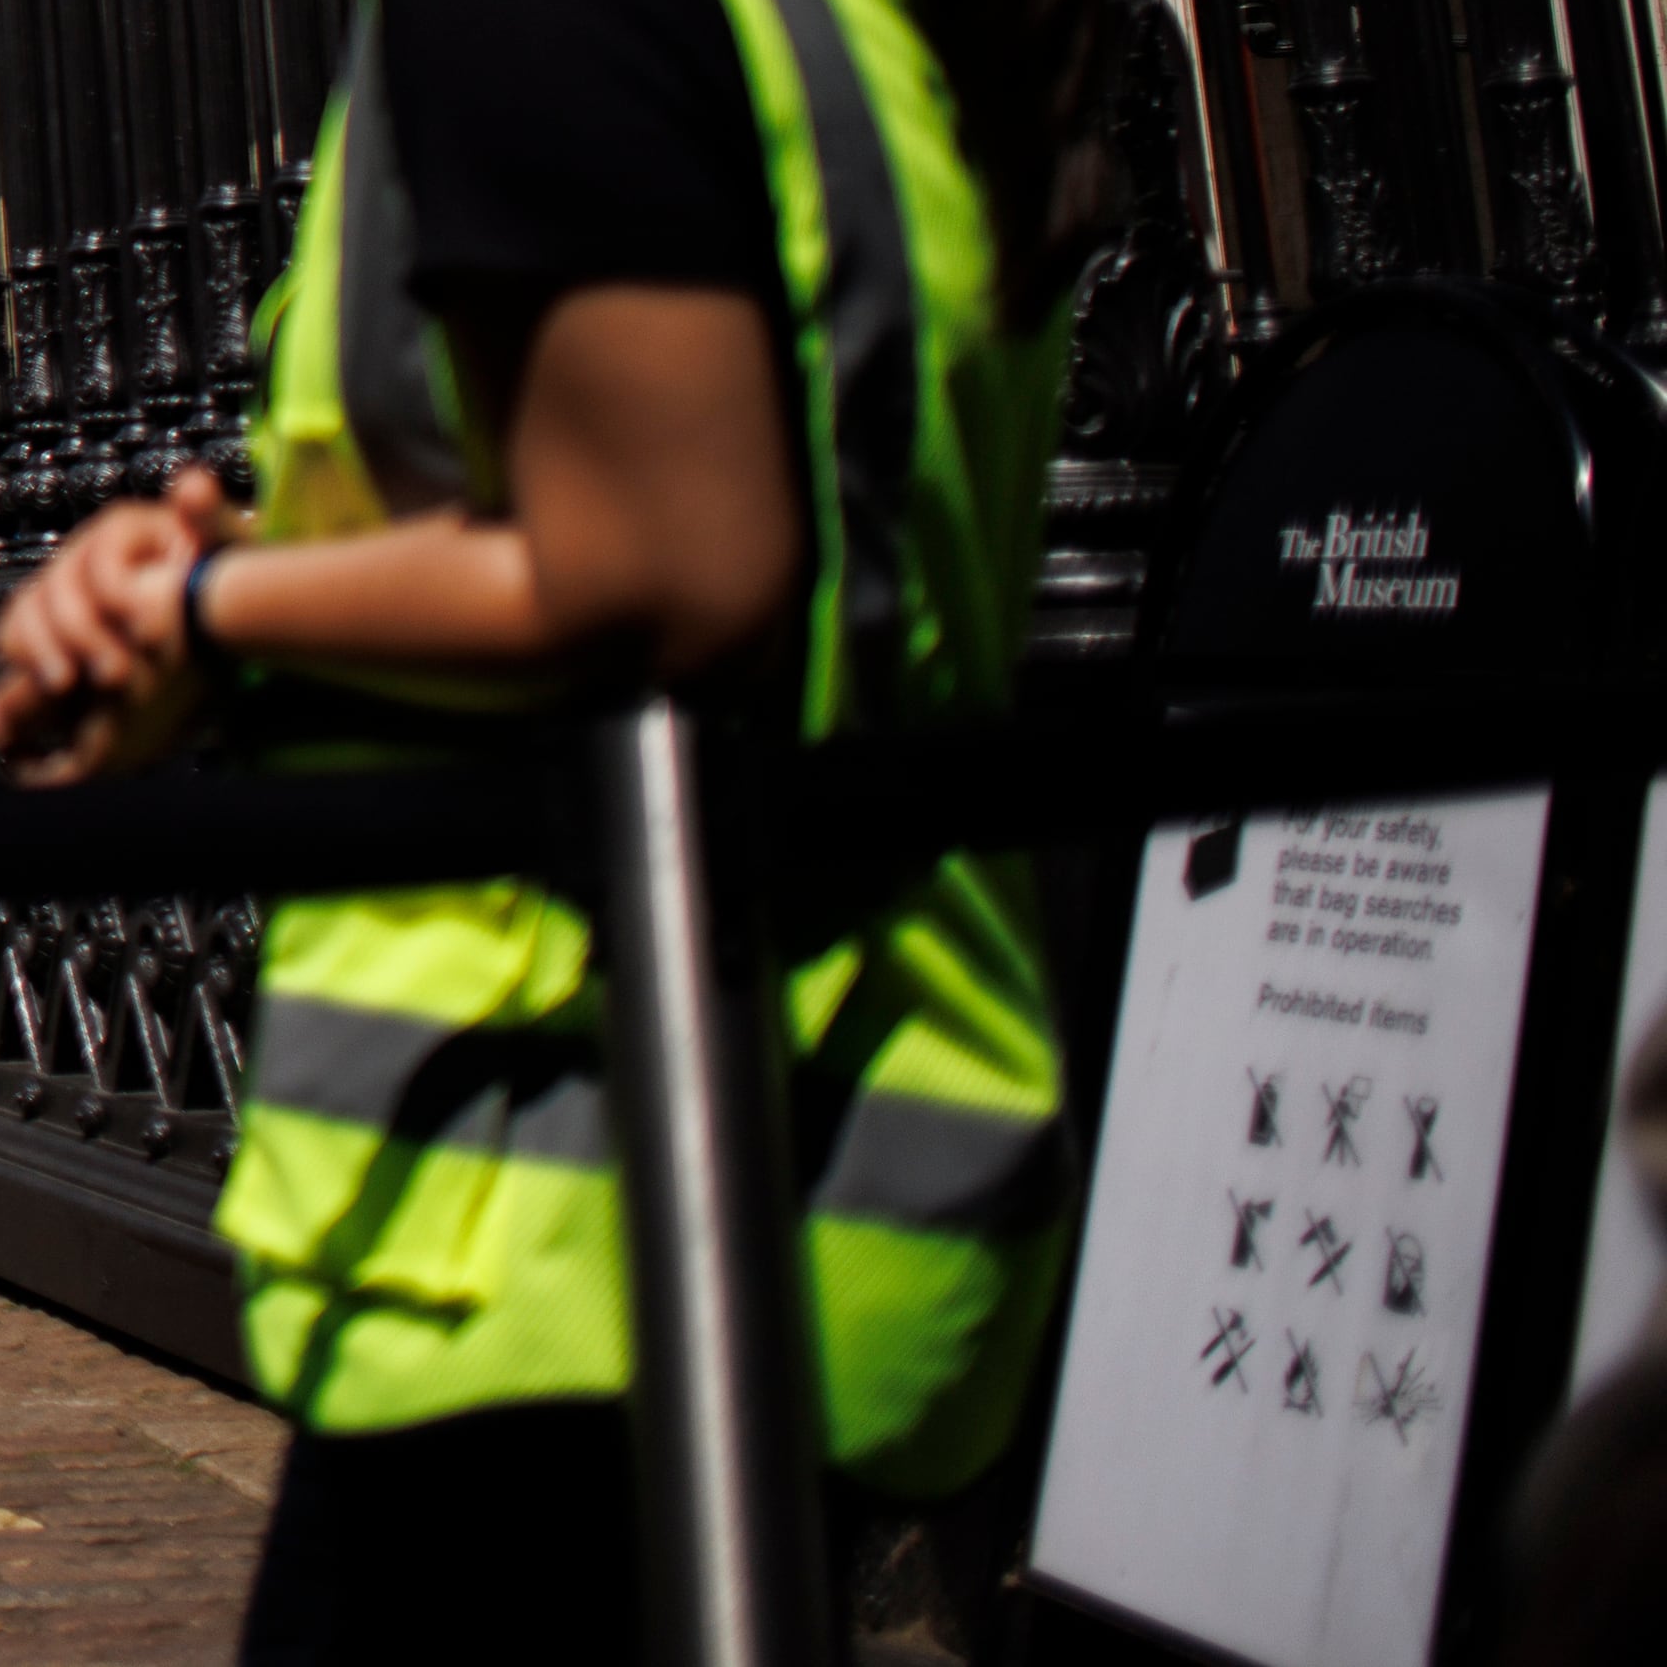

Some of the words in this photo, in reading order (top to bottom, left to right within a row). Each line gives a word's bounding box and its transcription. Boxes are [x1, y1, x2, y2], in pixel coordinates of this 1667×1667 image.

[1280, 529, 1322, 559] The
[1321, 511, 1429, 559] British
[1313, 563, 1460, 608] Museum
[1277, 844, 1346, 875] please
[1353, 849, 1380, 878] be
[1385, 859, 1451, 886] aware
[1273, 879, 1315, 908] that
[1319, 884, 1359, 920] bag
[1364, 895, 1462, 926] searches
[1268, 920, 1301, 943] are
[1306, 921, 1326, 946] in
[1258, 982, 1365, 1025] Prohibited
[1369, 1001, 1429, 1036] items
